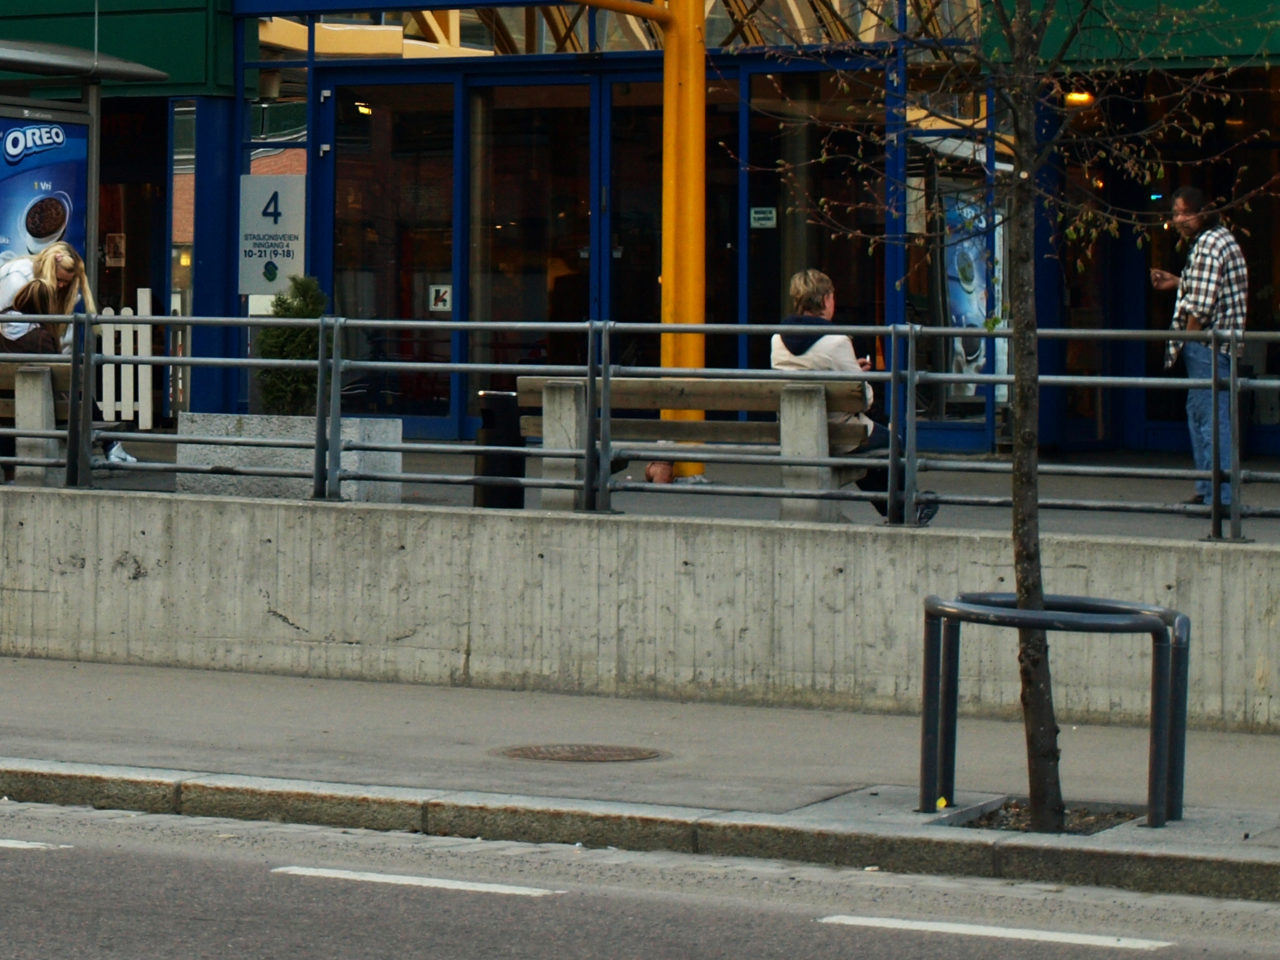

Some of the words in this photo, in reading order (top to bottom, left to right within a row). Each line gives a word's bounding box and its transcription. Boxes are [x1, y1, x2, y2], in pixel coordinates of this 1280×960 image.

[5, 127, 64, 156] OREO
[261, 190, 282, 225] 4
[244, 233, 299, 241] STASJONSVEIEN
[243, 249, 268, 258] 10-21
[269, 249, 295, 260] (9-18)
